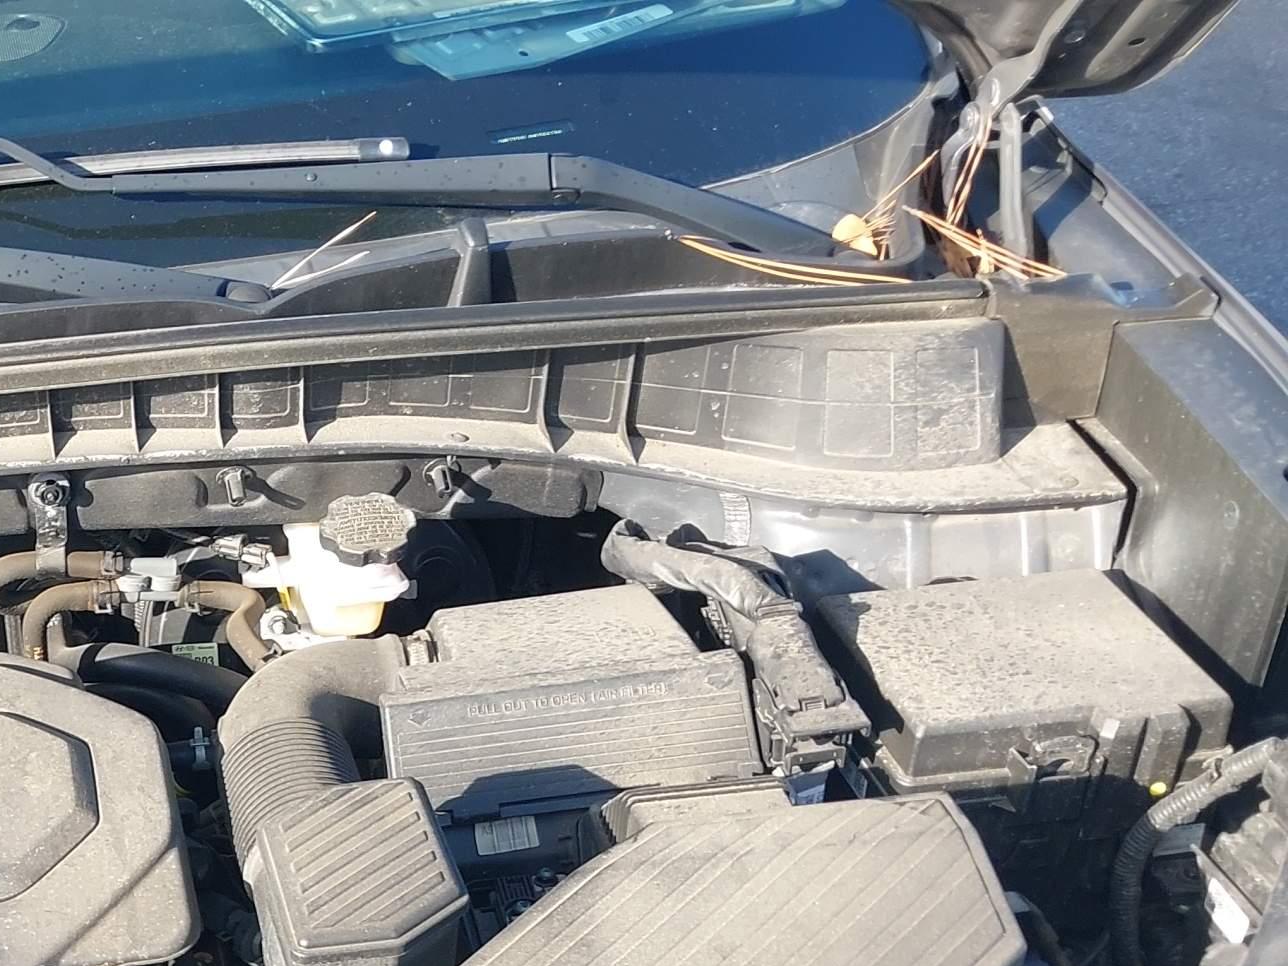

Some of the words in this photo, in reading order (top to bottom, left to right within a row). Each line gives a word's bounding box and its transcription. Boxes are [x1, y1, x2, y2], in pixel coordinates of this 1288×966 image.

[468, 702, 502, 718] PULL
[503, 699, 529, 713] OUT
[552, 691, 586, 707] OPEN
